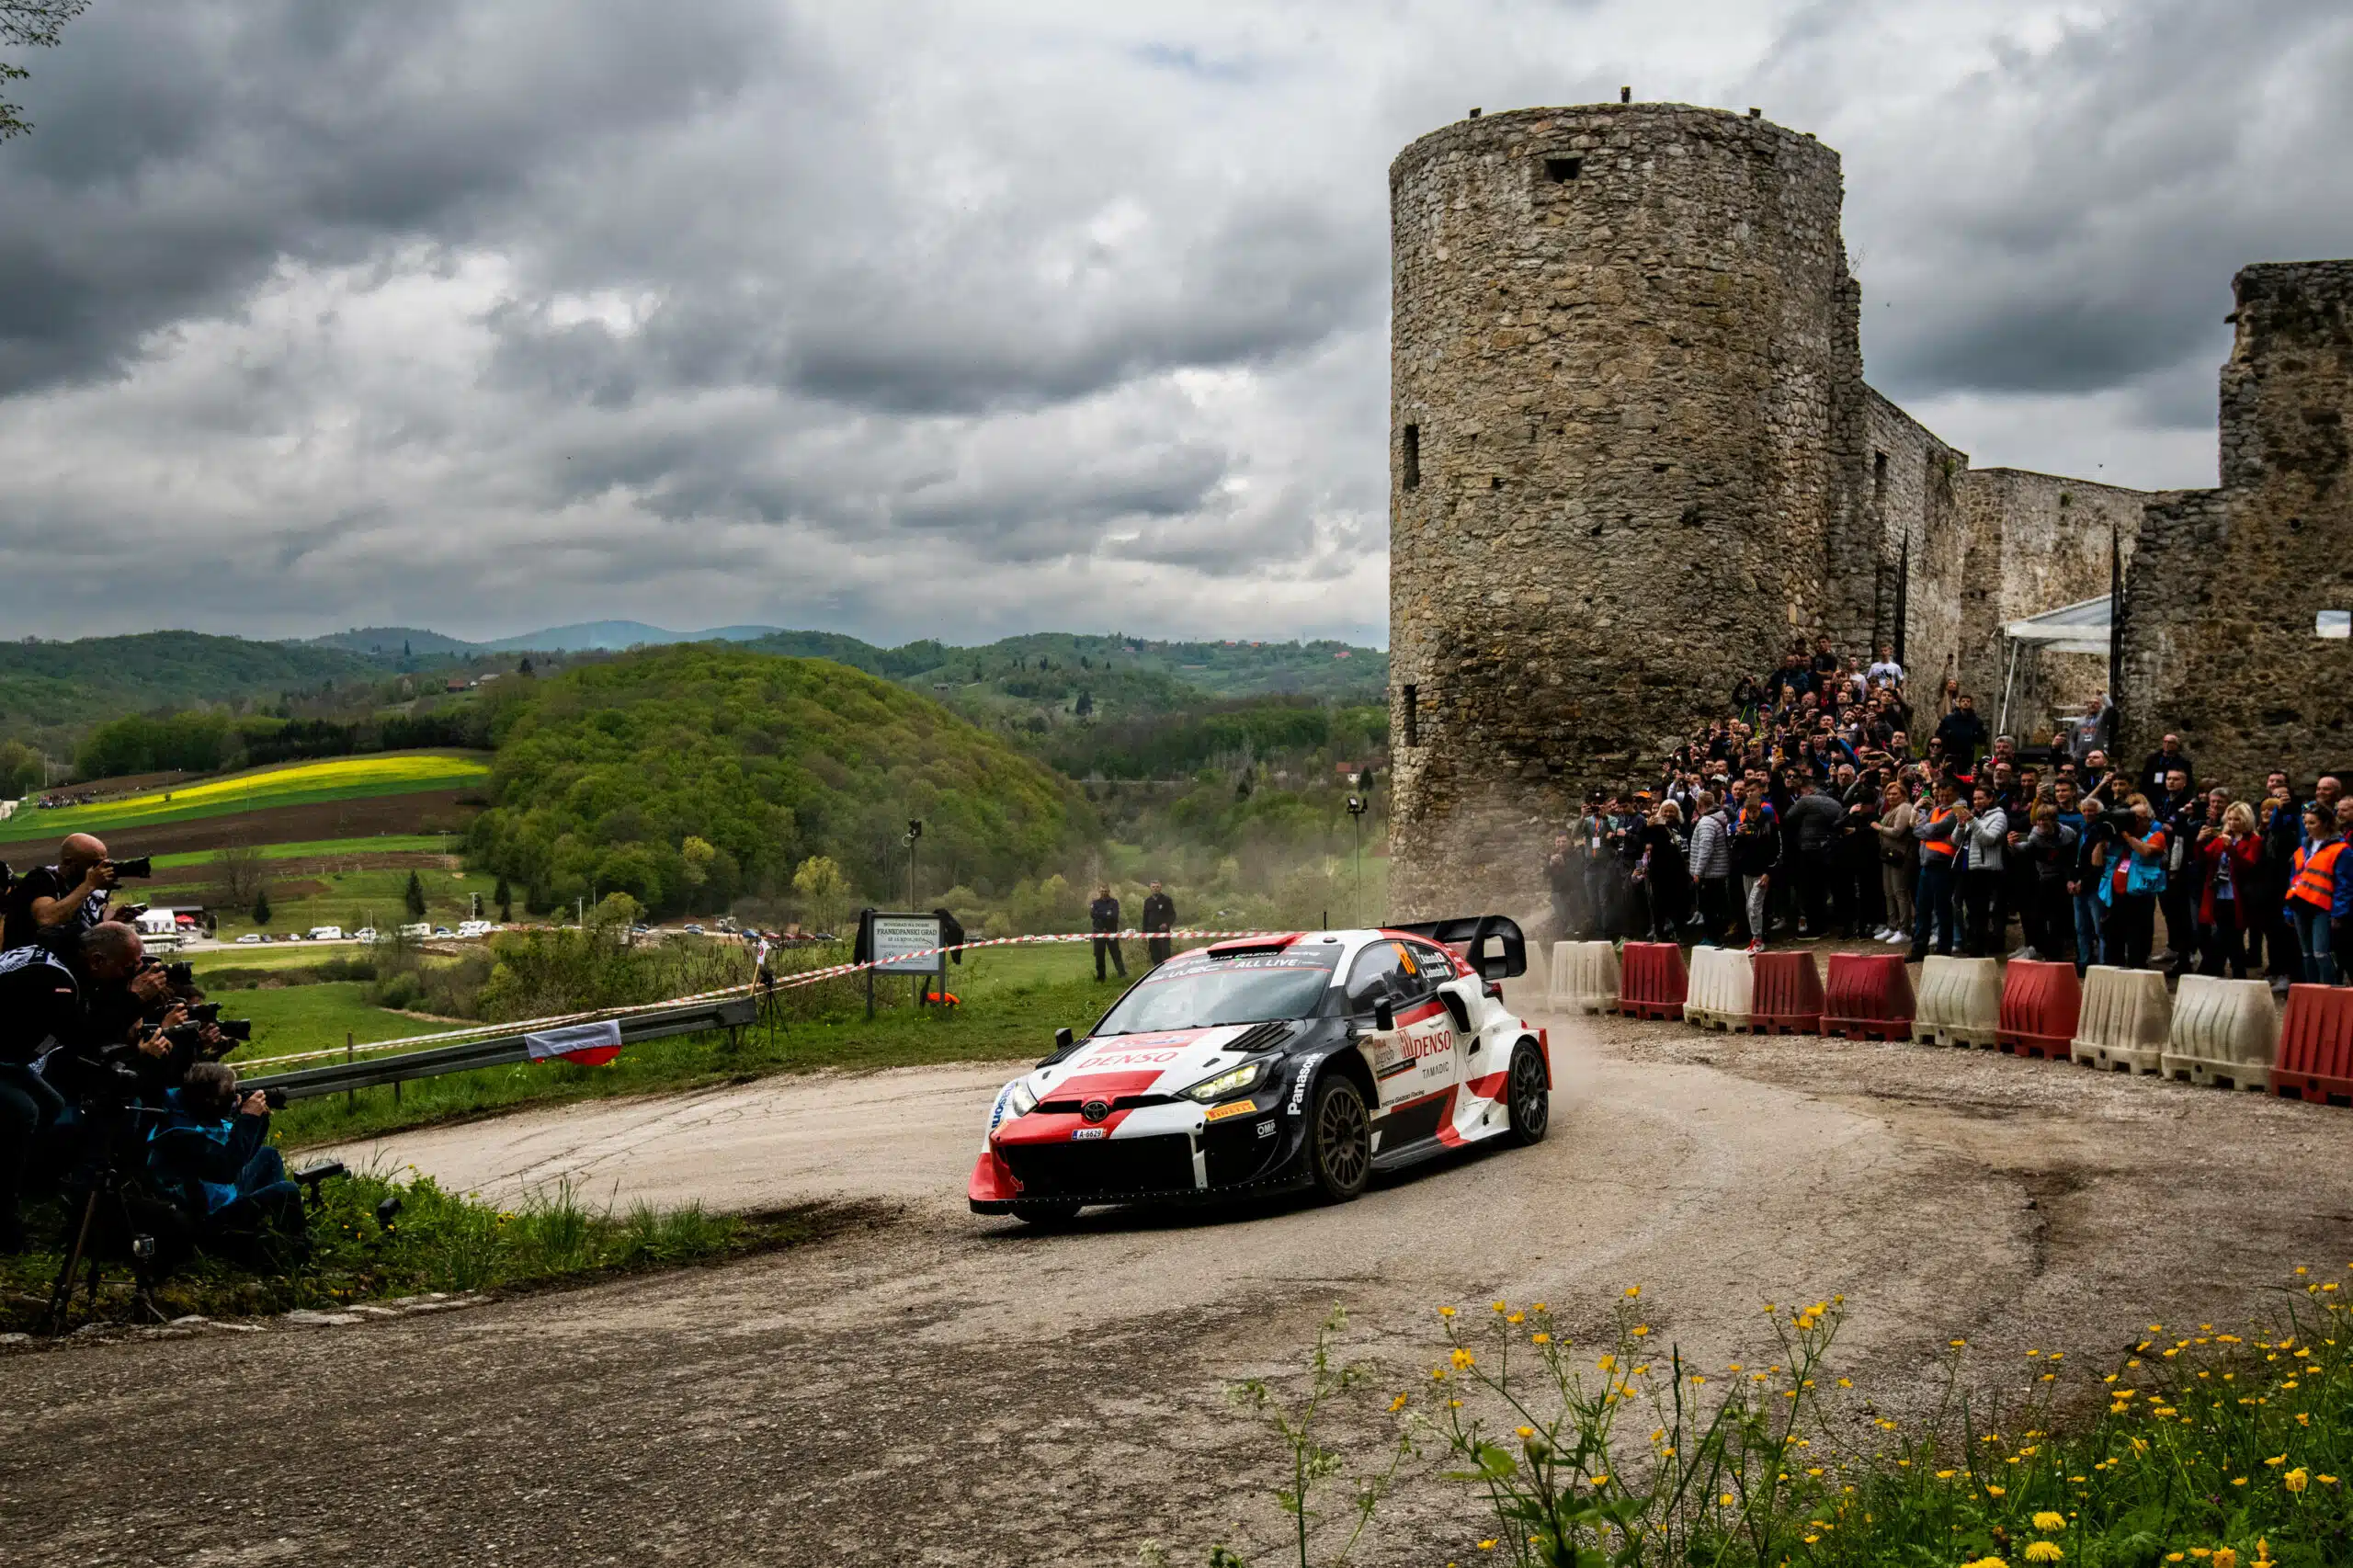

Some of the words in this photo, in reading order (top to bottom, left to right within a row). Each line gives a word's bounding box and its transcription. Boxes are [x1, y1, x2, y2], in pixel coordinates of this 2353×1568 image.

[1235, 960, 1261, 969] ALL
[1266, 958, 1298, 967] LIVE
[1414, 1029, 1452, 1059] DENSO
[1076, 1051, 1178, 1069] DENSO
[1422, 1062, 1449, 1079] TAMADIC
[1256, 1119, 1276, 1136] OMP
